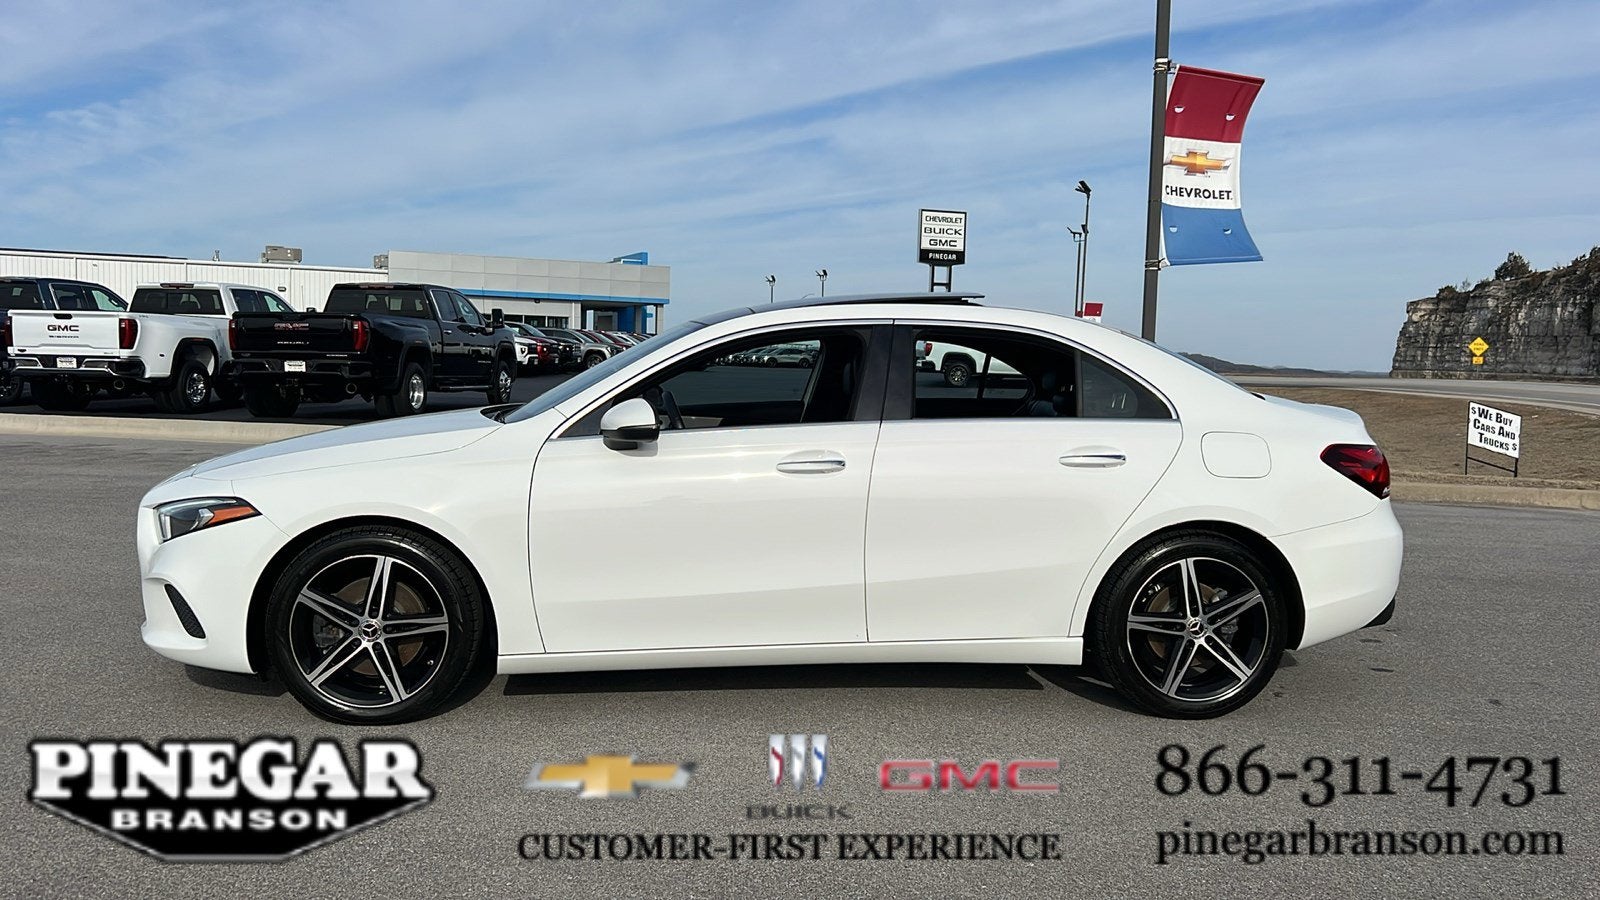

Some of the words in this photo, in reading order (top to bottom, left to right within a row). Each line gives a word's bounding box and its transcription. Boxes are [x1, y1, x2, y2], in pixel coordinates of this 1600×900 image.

[925, 215, 963, 224] CHEVROLET
[924, 226, 963, 236] BUICK
[929, 238, 957, 247] GMC
[928, 252, 957, 260] PINEGAR
[47, 324, 80, 332] GMC
